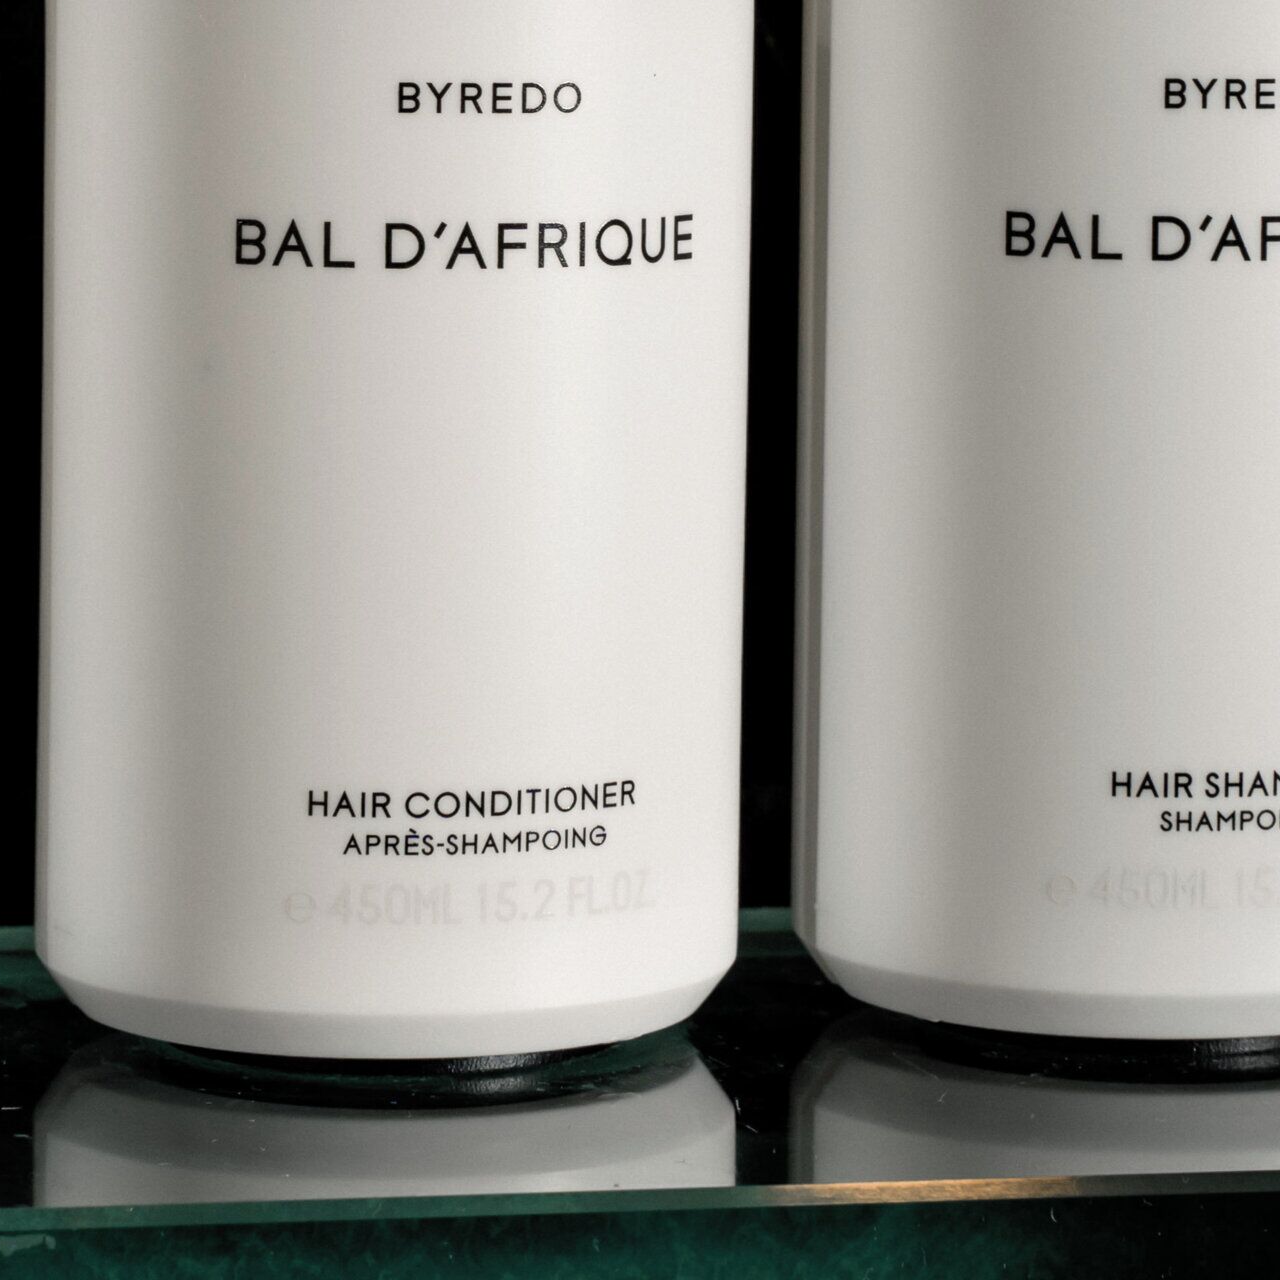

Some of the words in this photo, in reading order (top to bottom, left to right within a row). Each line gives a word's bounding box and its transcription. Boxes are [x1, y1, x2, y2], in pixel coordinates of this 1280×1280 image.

[396, 79, 584, 116] BYREDO
[234, 216, 357, 271] BAL
[383, 211, 696, 271] D'AFRIQUE
[1004, 208, 1124, 263] BAL
[306, 789, 392, 819] HAIR
[403, 778, 637, 821] CONDITIONER
[1109, 769, 1194, 800] HAIR
[341, 824, 609, 858] APRÈS-SHAMPOING
[328, 882, 462, 926] 450ML
[478, 877, 556, 923] 15.2
